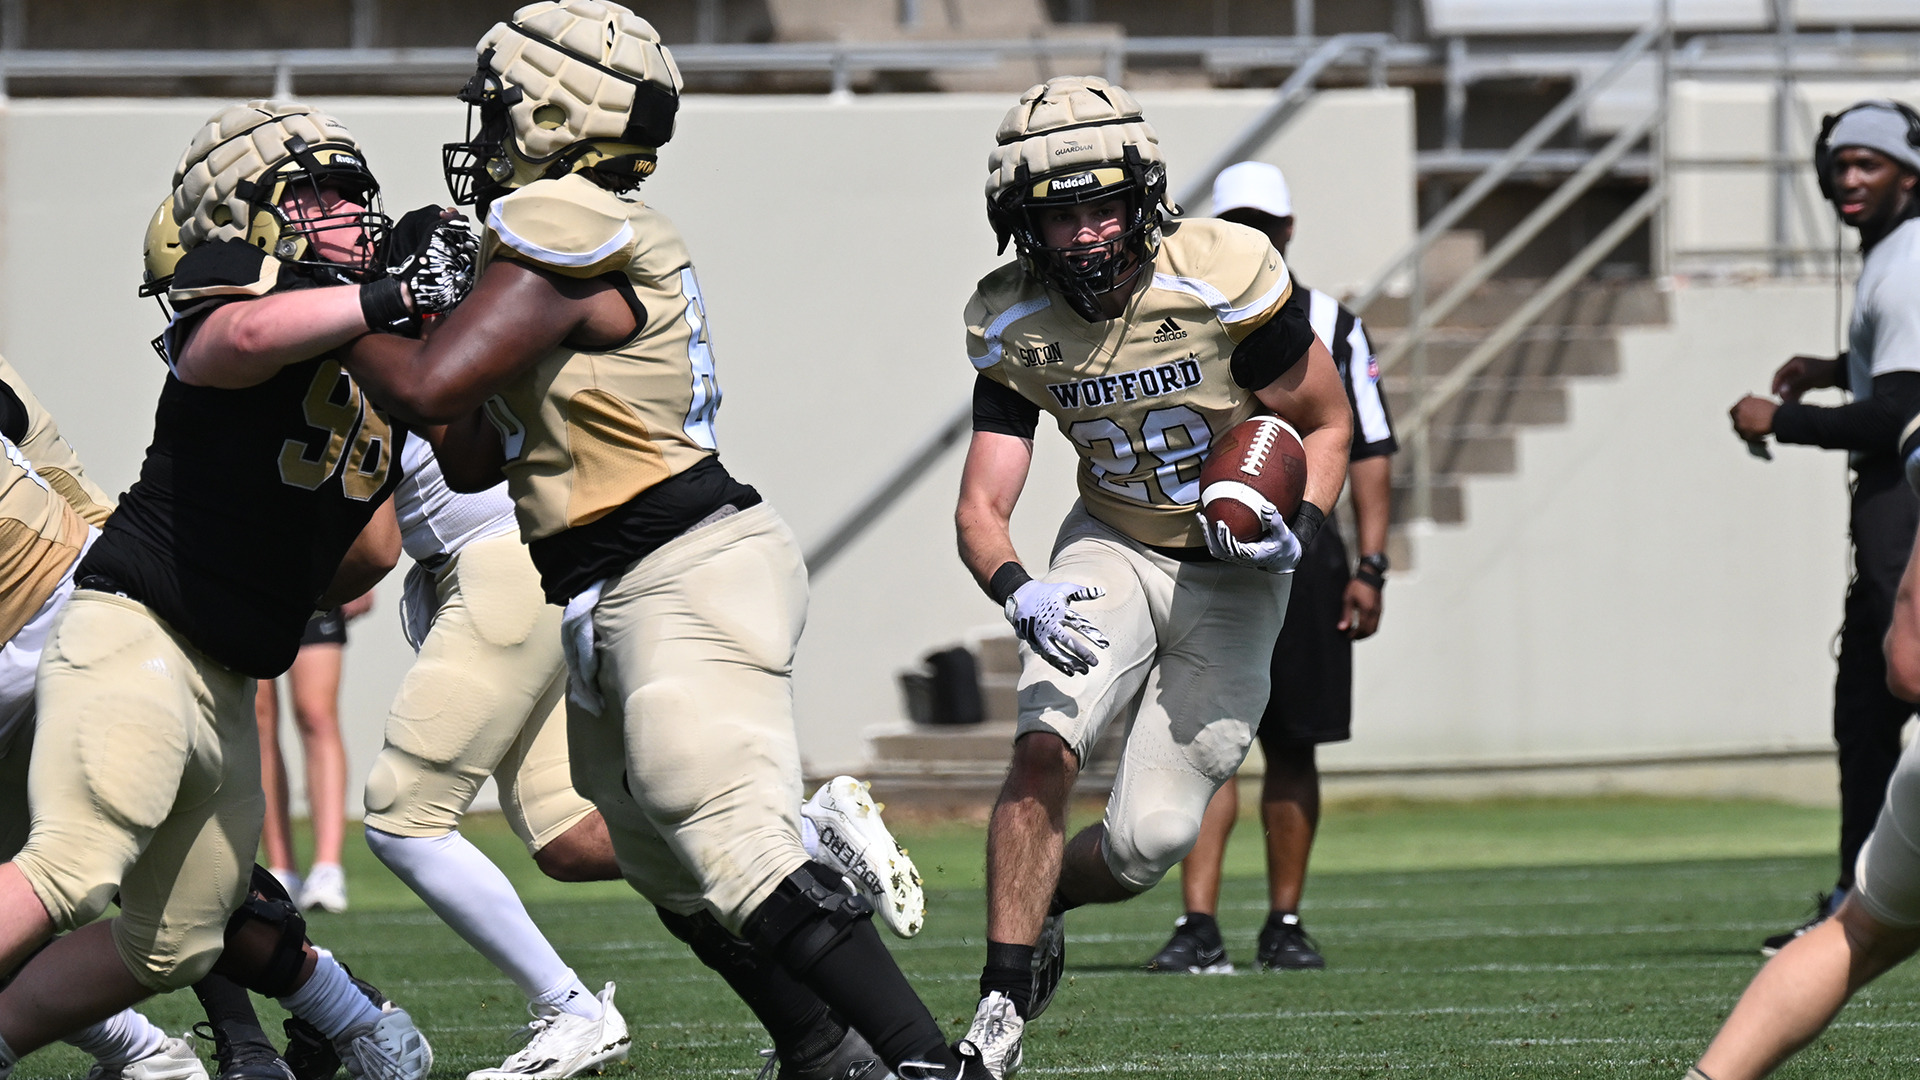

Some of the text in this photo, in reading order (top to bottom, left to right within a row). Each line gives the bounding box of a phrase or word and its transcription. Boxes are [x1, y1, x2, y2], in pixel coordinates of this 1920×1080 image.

[1055, 144, 1093, 155] GUARDIAN
[1051, 173, 1093, 190] Riddell
[1153, 330, 1187, 343] adidas
[1046, 359, 1203, 409] WOFFORD
[1068, 405, 1214, 505] 28
